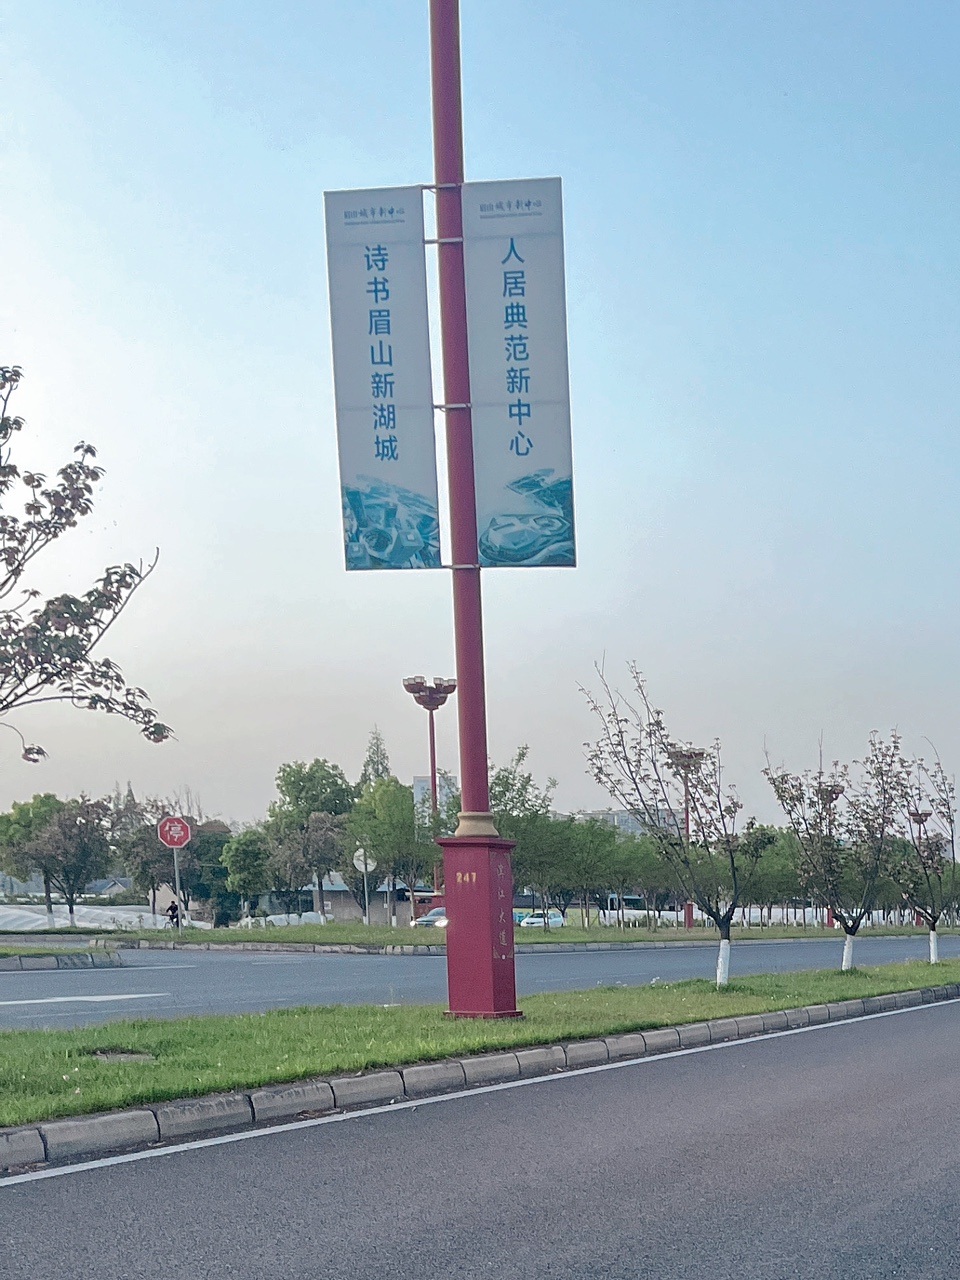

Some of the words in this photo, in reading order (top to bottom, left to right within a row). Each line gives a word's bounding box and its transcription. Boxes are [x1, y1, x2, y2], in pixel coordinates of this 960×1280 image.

[364, 244, 398, 461] 诗书眉山新湖城
[501, 237, 534, 457] 人居典范新中心
[164, 821, 184, 842] 停
[456, 872, 477, 883] 247
